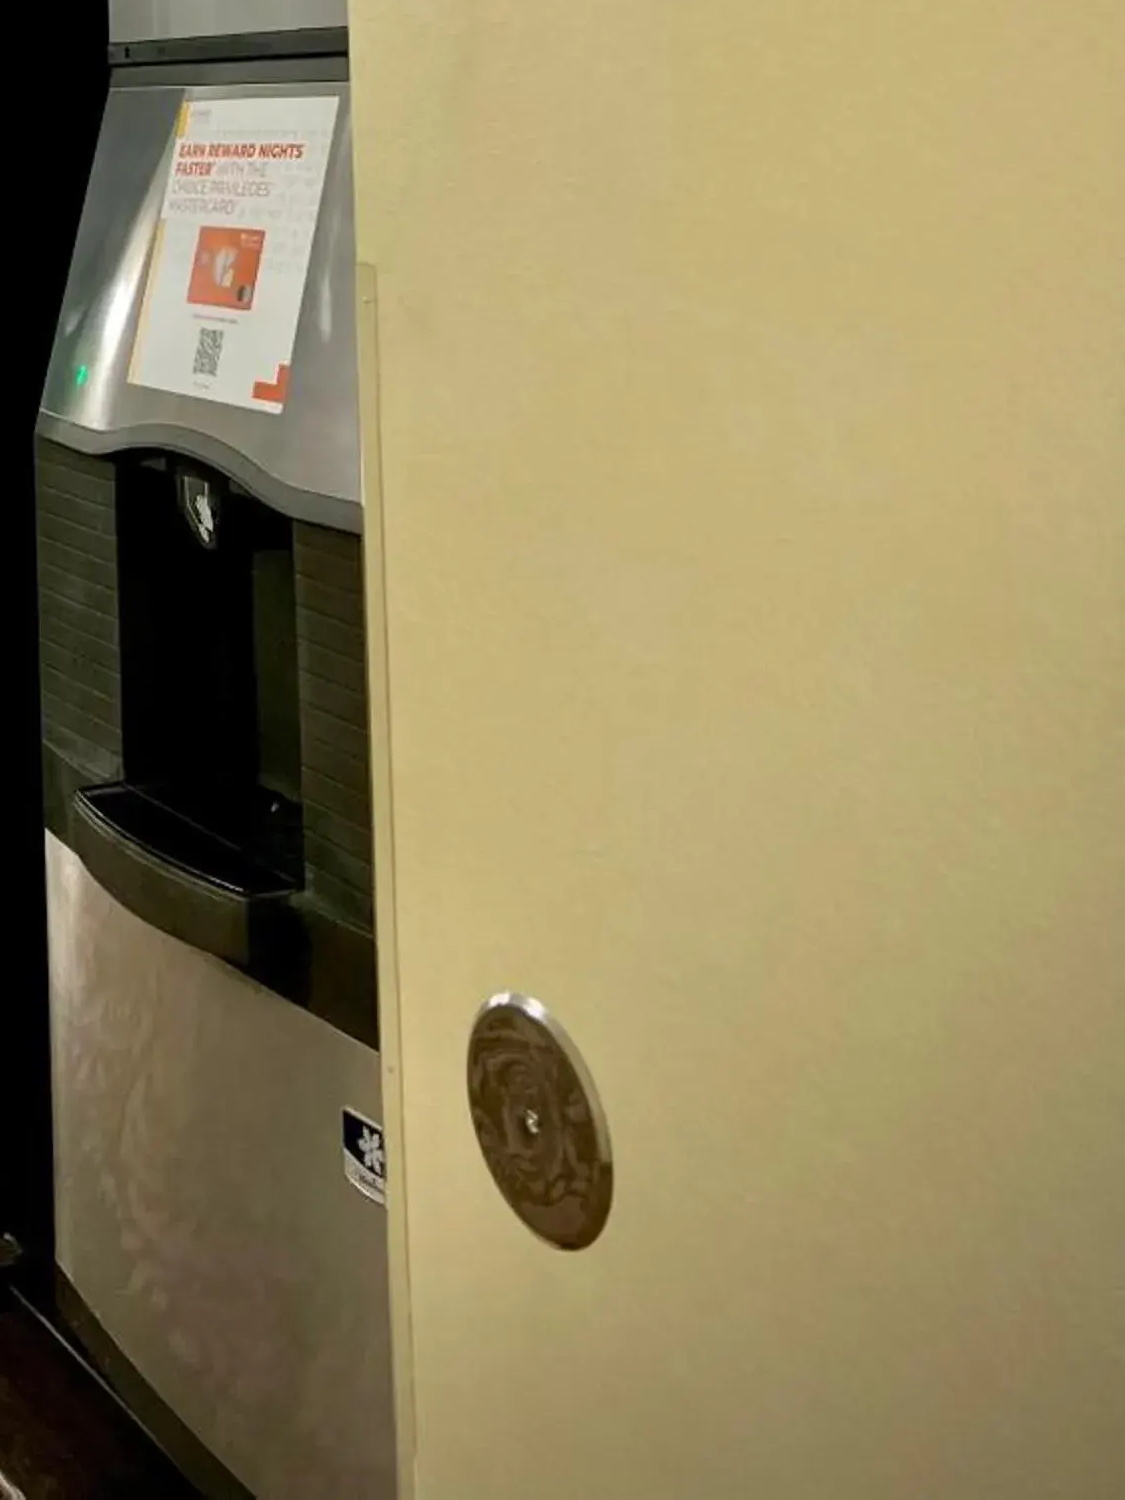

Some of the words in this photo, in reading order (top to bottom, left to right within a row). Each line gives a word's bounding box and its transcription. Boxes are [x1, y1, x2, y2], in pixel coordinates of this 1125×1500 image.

[178, 143, 206, 158] EARN
[206, 143, 256, 158] REWARD
[257, 143, 305, 160] NIGHTS
